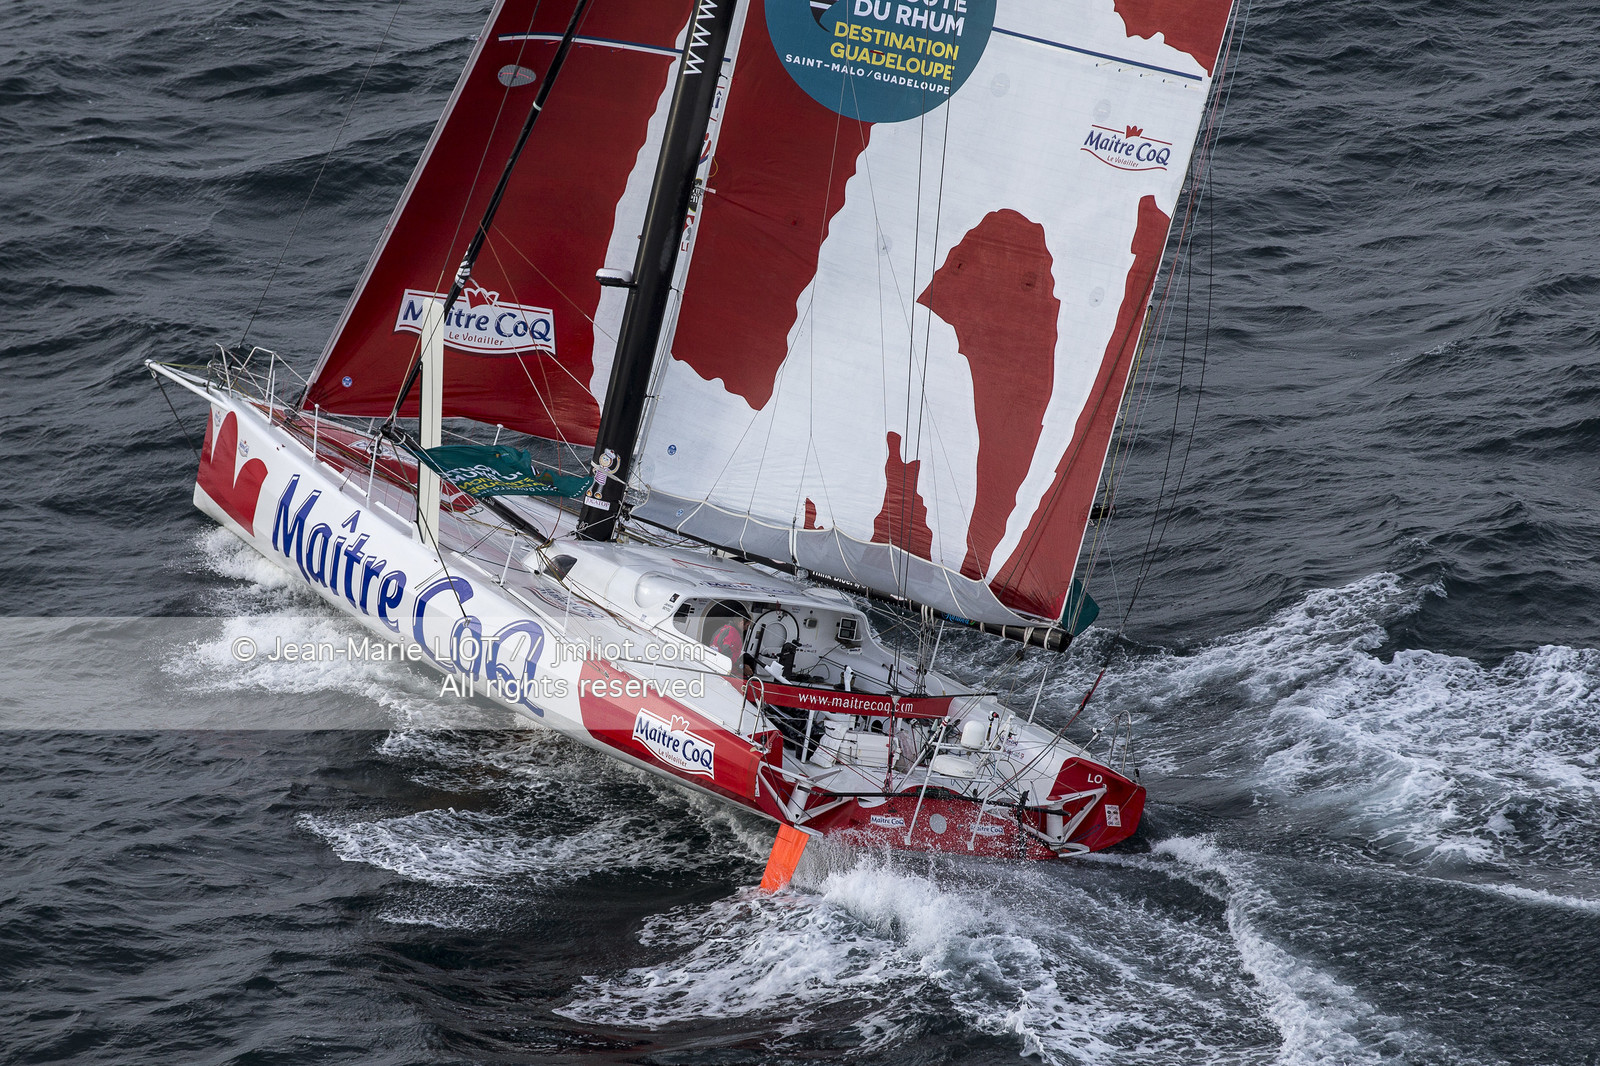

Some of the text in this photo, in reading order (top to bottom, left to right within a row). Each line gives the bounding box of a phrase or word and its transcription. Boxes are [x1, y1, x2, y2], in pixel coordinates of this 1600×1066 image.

[853, 0, 891, 20] DU
[895, 4, 965, 37] RHUM
[834, 21, 959, 61] DESTINATION
[830, 42, 956, 81] GUADELOUPE
[1084, 130, 1171, 166] Maître CoQ
[403, 300, 552, 342] Mître CoQ
[449, 331, 504, 346] Le Volailler
[271, 474, 546, 718] Maître CoQ
[635, 717, 713, 770] Maître CoQ
[1087, 773, 1103, 784] LO
